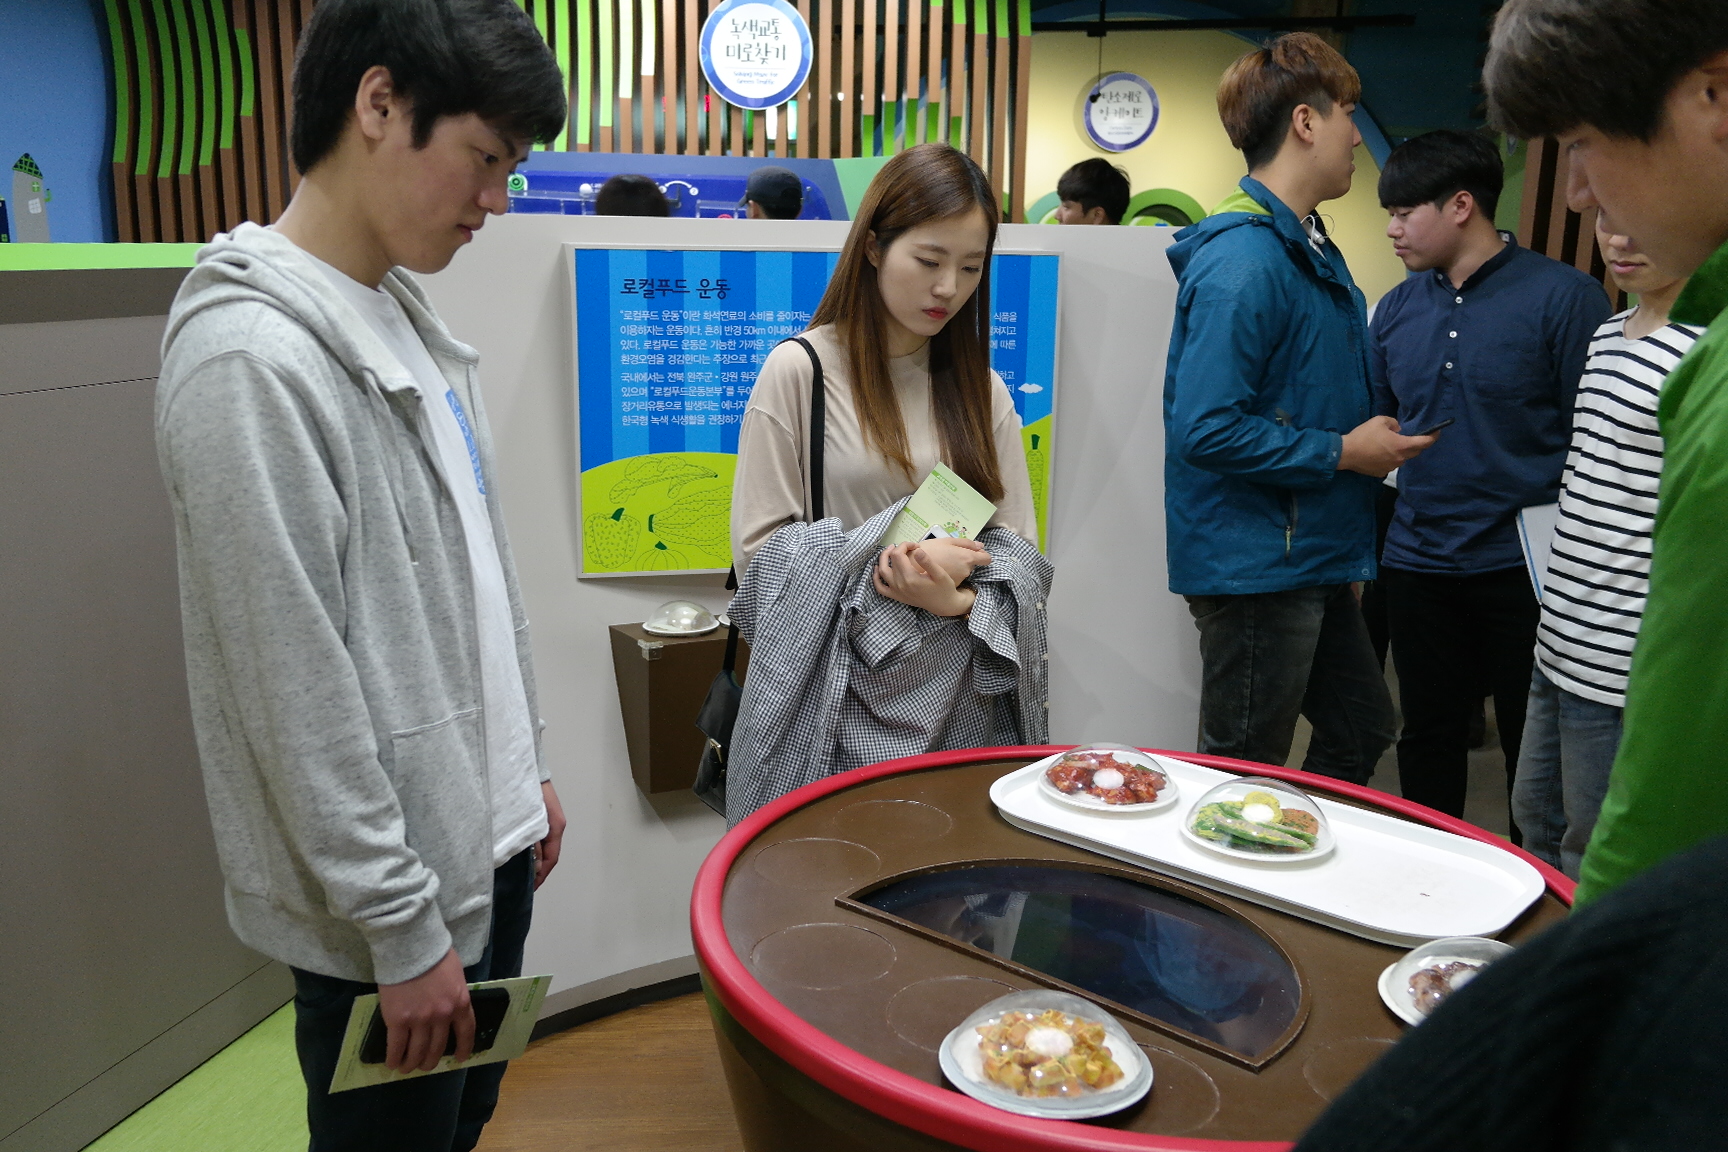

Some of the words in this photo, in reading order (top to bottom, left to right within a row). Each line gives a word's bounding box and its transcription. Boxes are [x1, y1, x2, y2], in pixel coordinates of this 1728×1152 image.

[730, 18, 782, 41] 녹색교통
[726, 42, 786, 65] 미로찾기
[620, 278, 690, 299] 로컬푸드
[696, 278, 731, 299] 운동
[703, 310, 746, 321] 화석연료의
[749, 311, 774, 321] 소비를
[993, 311, 1017, 322] 식품을
[620, 324, 664, 336] 이용하자는
[666, 325, 702, 336] 운동이다.
[705, 325, 722, 336] 흔히
[724, 325, 742, 336] 반경
[743, 326, 766, 335] 50km
[767, 325, 801, 335] 이내에서
[990, 326, 1016, 336] 쳐지고
[620, 339, 641, 350] 있다.
[643, 339, 679, 350] 로컬푸드
[681, 339, 707, 350] 운동은
[710, 339, 736, 350] 가능한
[739, 339, 765, 350] 가까운
[1000, 340, 1016, 350] 따른
[621, 353, 665, 365] 환경오염을
[667, 354, 711, 365] 경감한다는
[713, 354, 748, 365] 주장으로
[621, 372, 665, 382] 국내에서는
[667, 372, 684, 382] 전북
[621, 386, 648, 397] 있으며
[621, 400, 682, 412] 장거리유통으로
[685, 400, 719, 411] 발생되는
[622, 415, 648, 426] 한국형
[651, 414, 668, 425] 녹색
[671, 414, 705, 425] 식생활을
